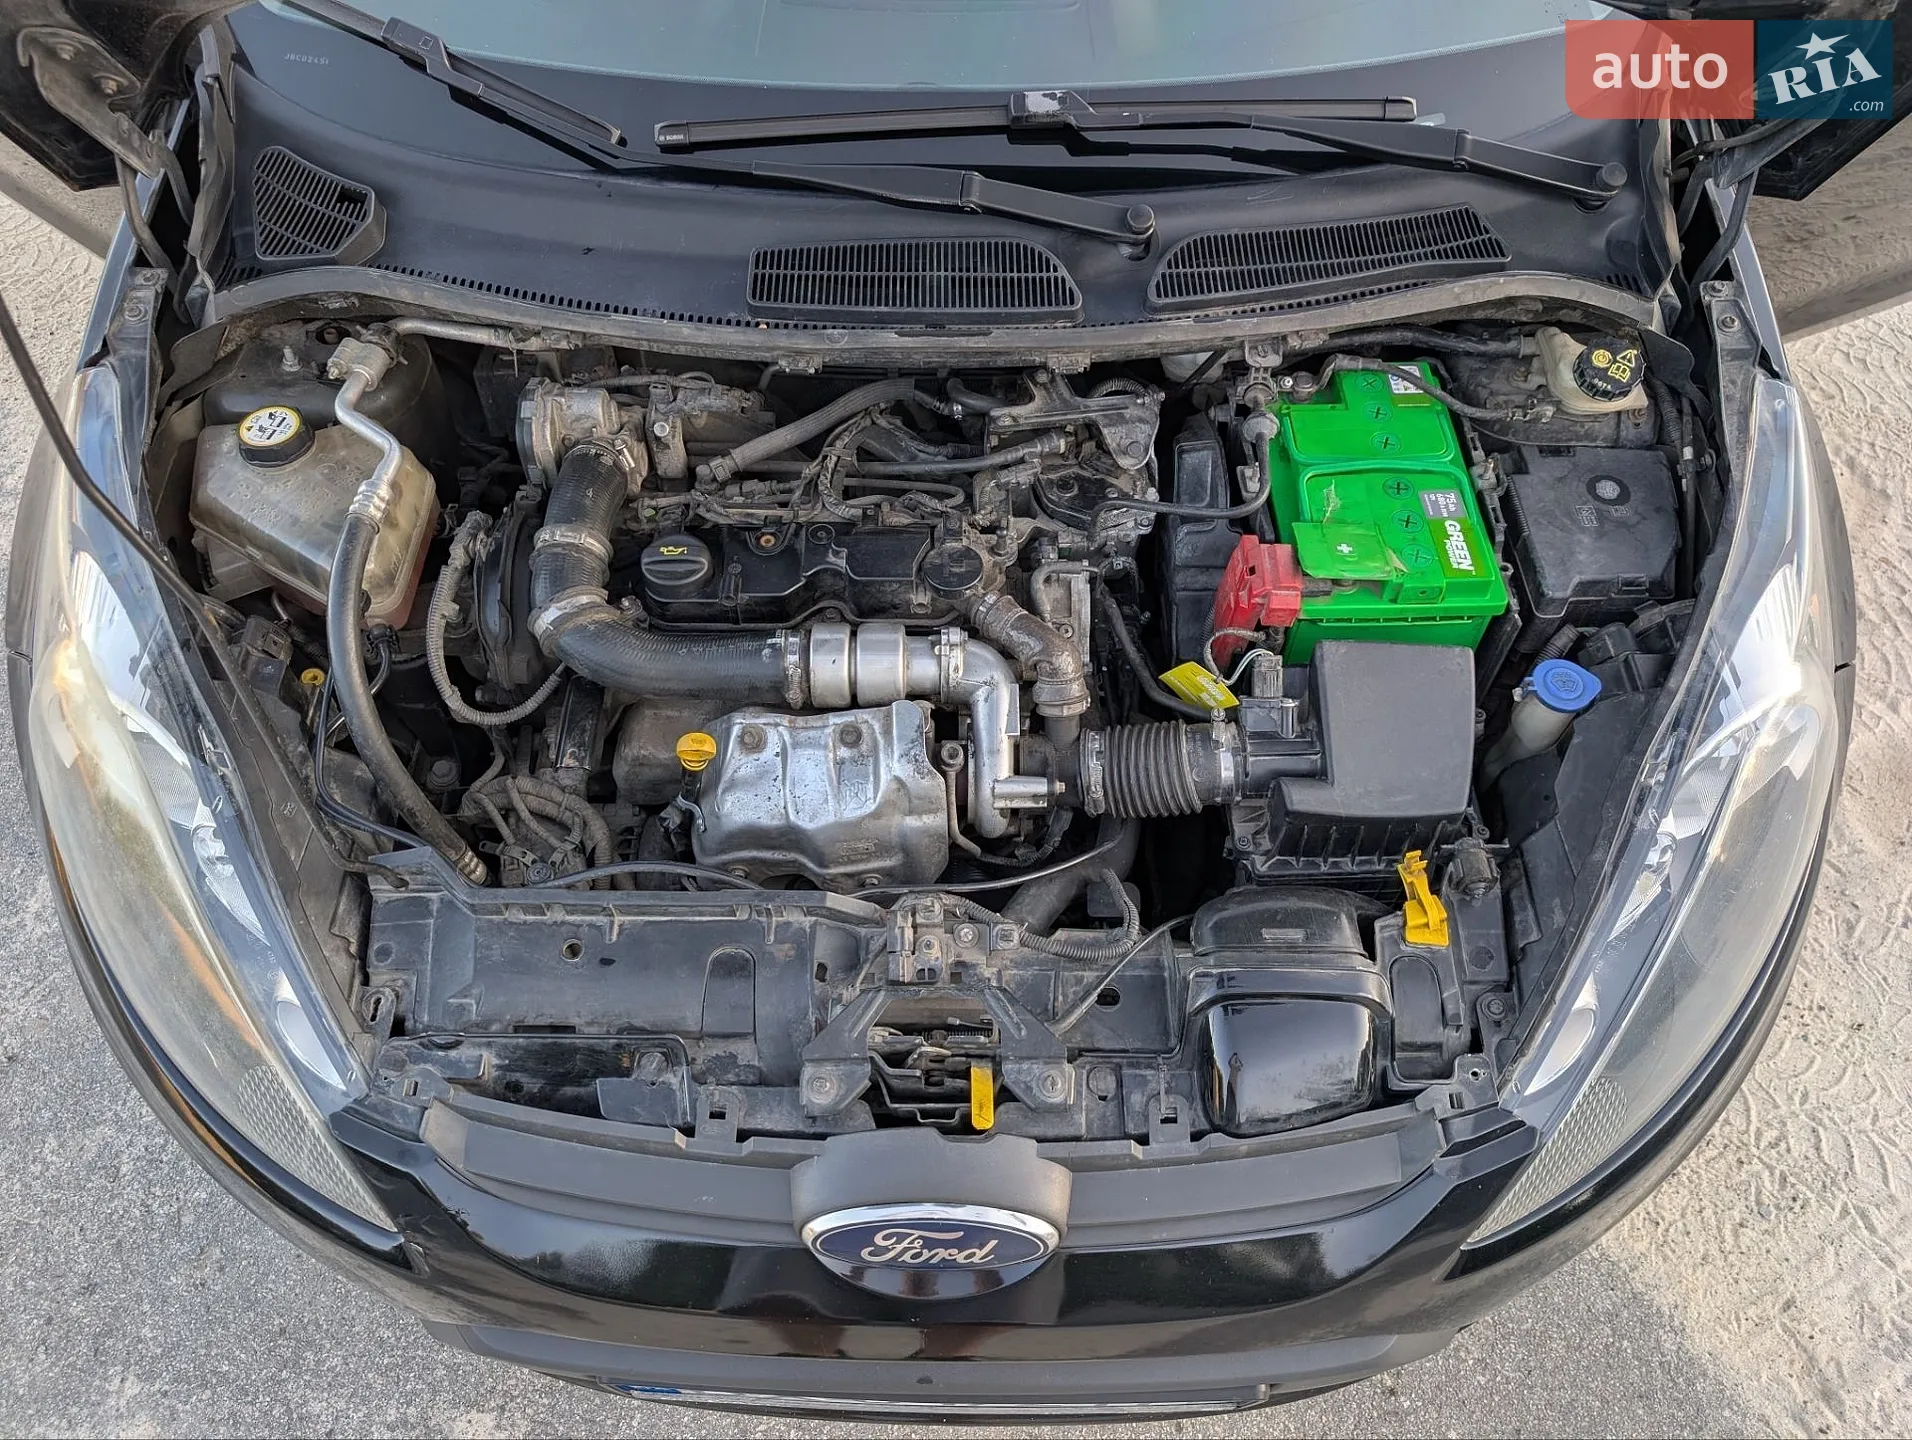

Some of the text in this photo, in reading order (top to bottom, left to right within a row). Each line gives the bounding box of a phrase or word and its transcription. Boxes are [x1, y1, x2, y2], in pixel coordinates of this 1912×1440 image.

[1443, 539, 1459, 569] POWER
[1444, 520, 1475, 571] GREEN
[860, 1228, 999, 1264] Ford
